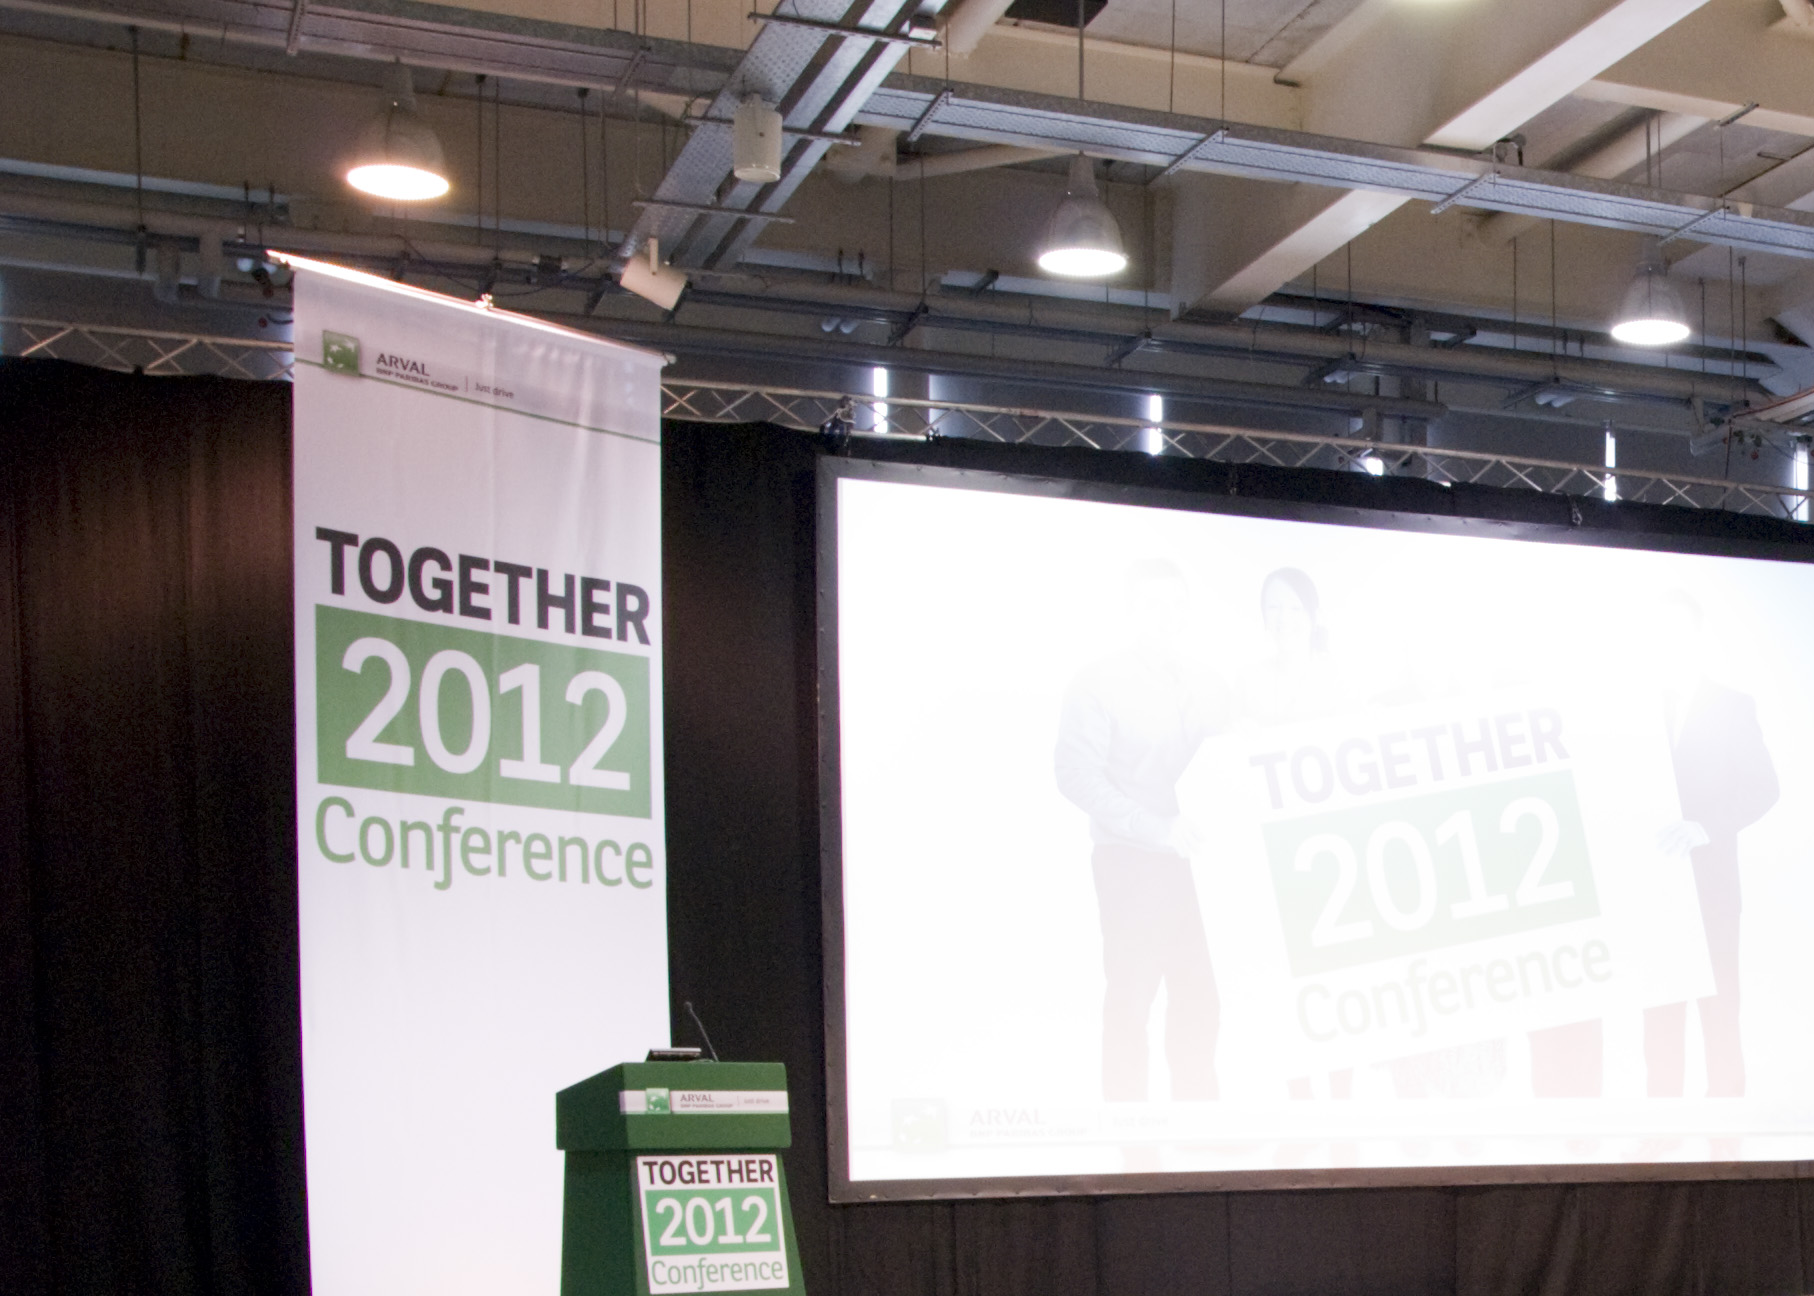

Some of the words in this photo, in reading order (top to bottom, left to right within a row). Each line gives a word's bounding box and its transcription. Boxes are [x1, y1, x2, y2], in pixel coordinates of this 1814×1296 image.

[376, 353, 430, 377] ARVAL
[492, 385, 515, 399] drive
[316, 527, 651, 645] TOGETHER
[341, 637, 631, 791] 2012
[1250, 706, 1571, 810] TOGETHER
[316, 796, 654, 890] Conference
[1292, 797, 1576, 949] 2012
[1297, 935, 1613, 1045] Conference
[680, 1094, 714, 1102] ARVAL
[969, 1108, 1047, 1127] ARVAL
[643, 1160, 774, 1185] TOGETHER
[655, 1195, 771, 1247] 2012
[651, 1258, 784, 1290] Conference
